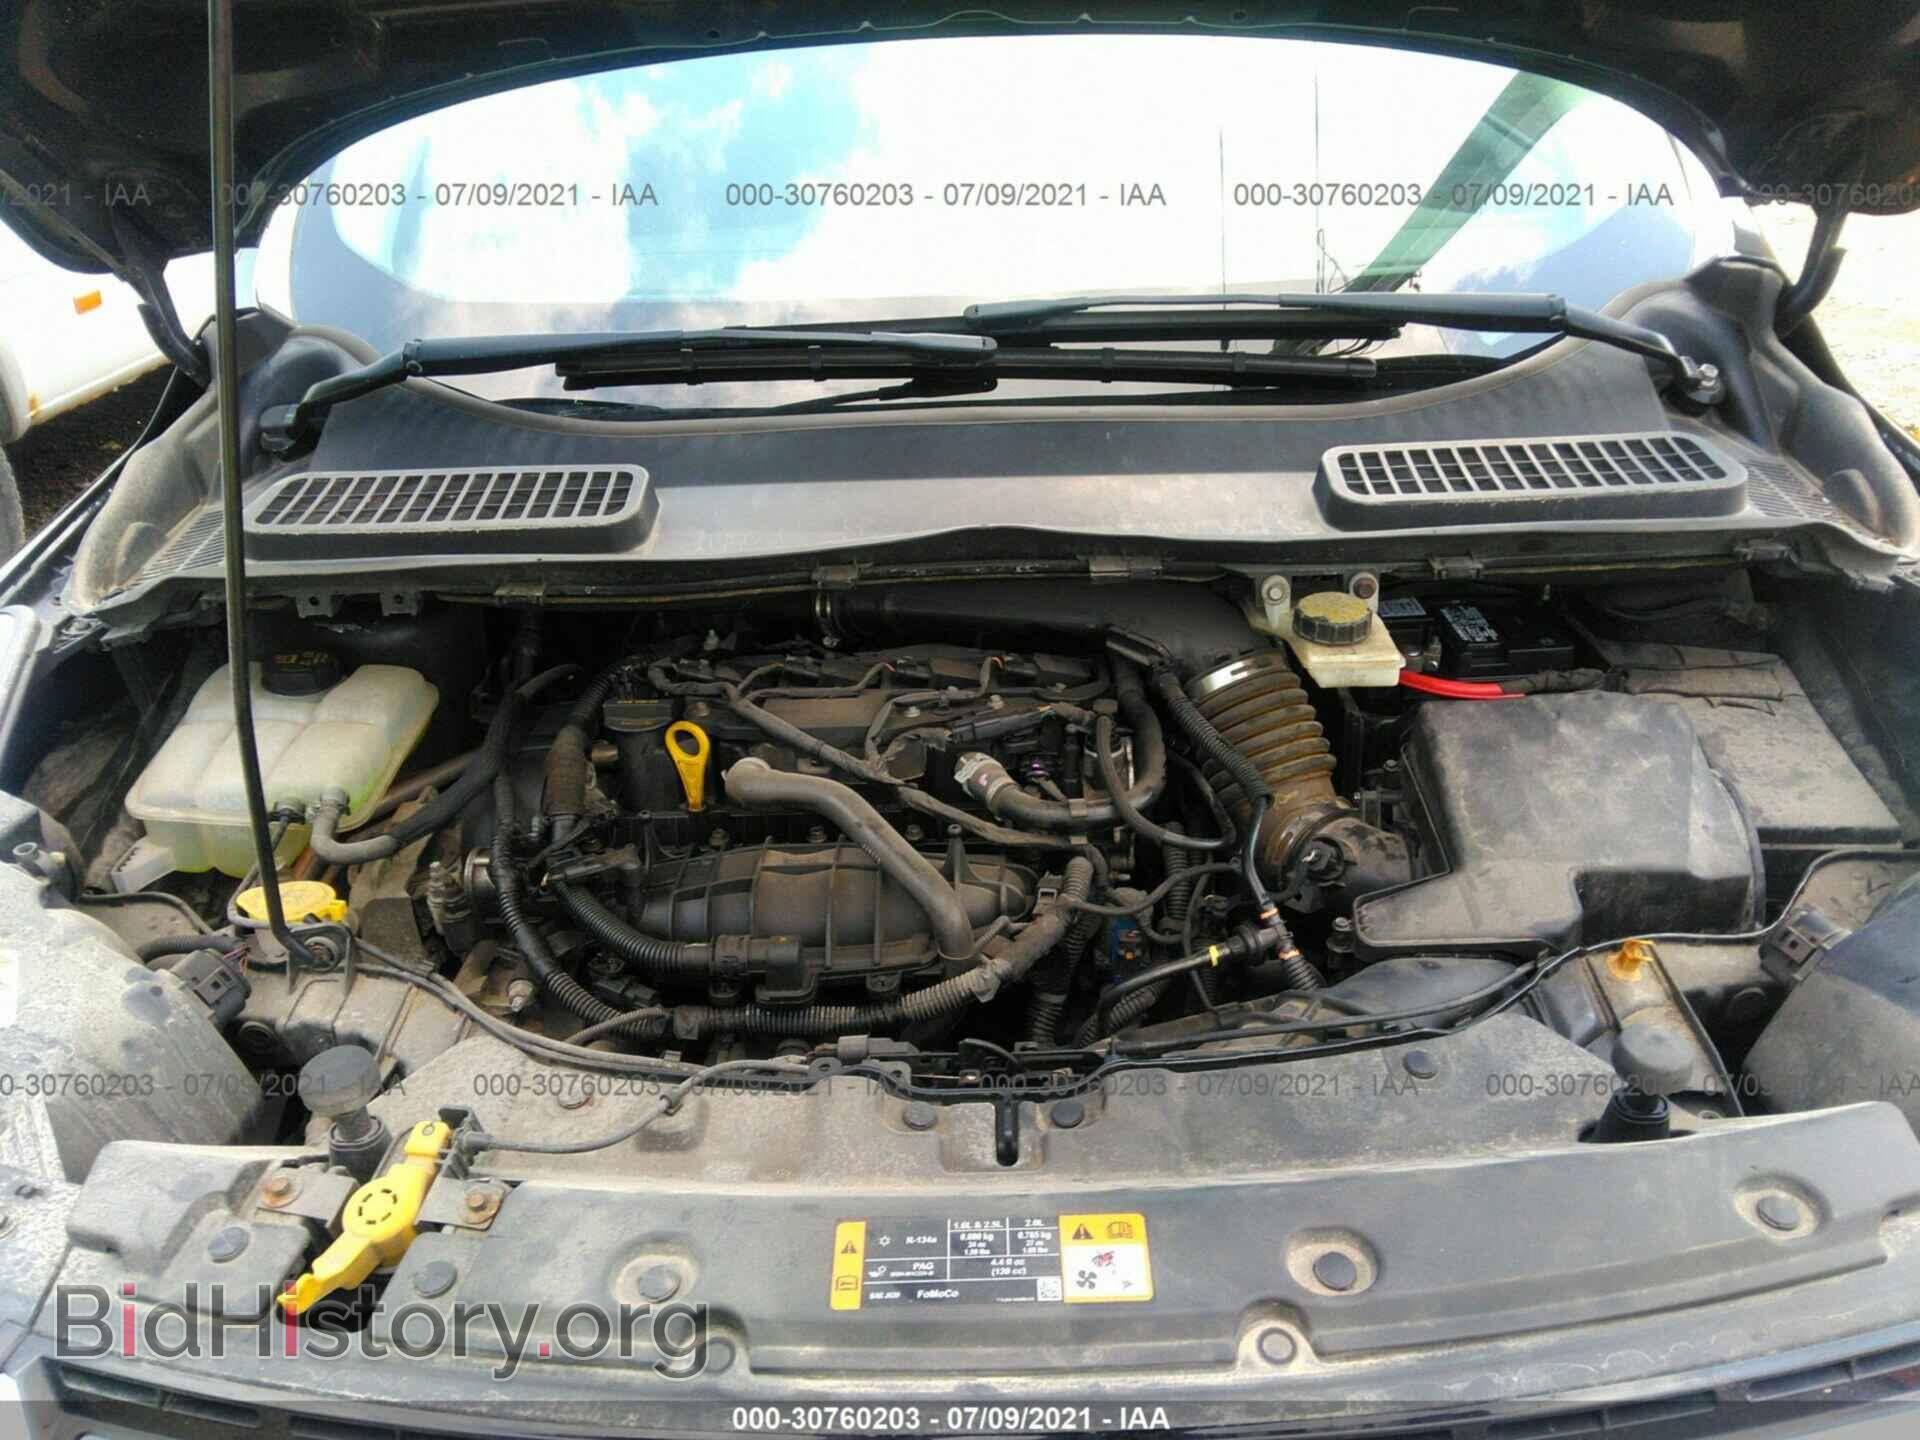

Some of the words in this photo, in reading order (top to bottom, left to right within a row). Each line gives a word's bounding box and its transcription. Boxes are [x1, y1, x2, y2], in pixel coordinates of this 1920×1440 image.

[905, 1236, 937, 1245] R-134a
[912, 1262, 934, 1270] PAG
[916, 1289, 960, 1299] FoMoCo
